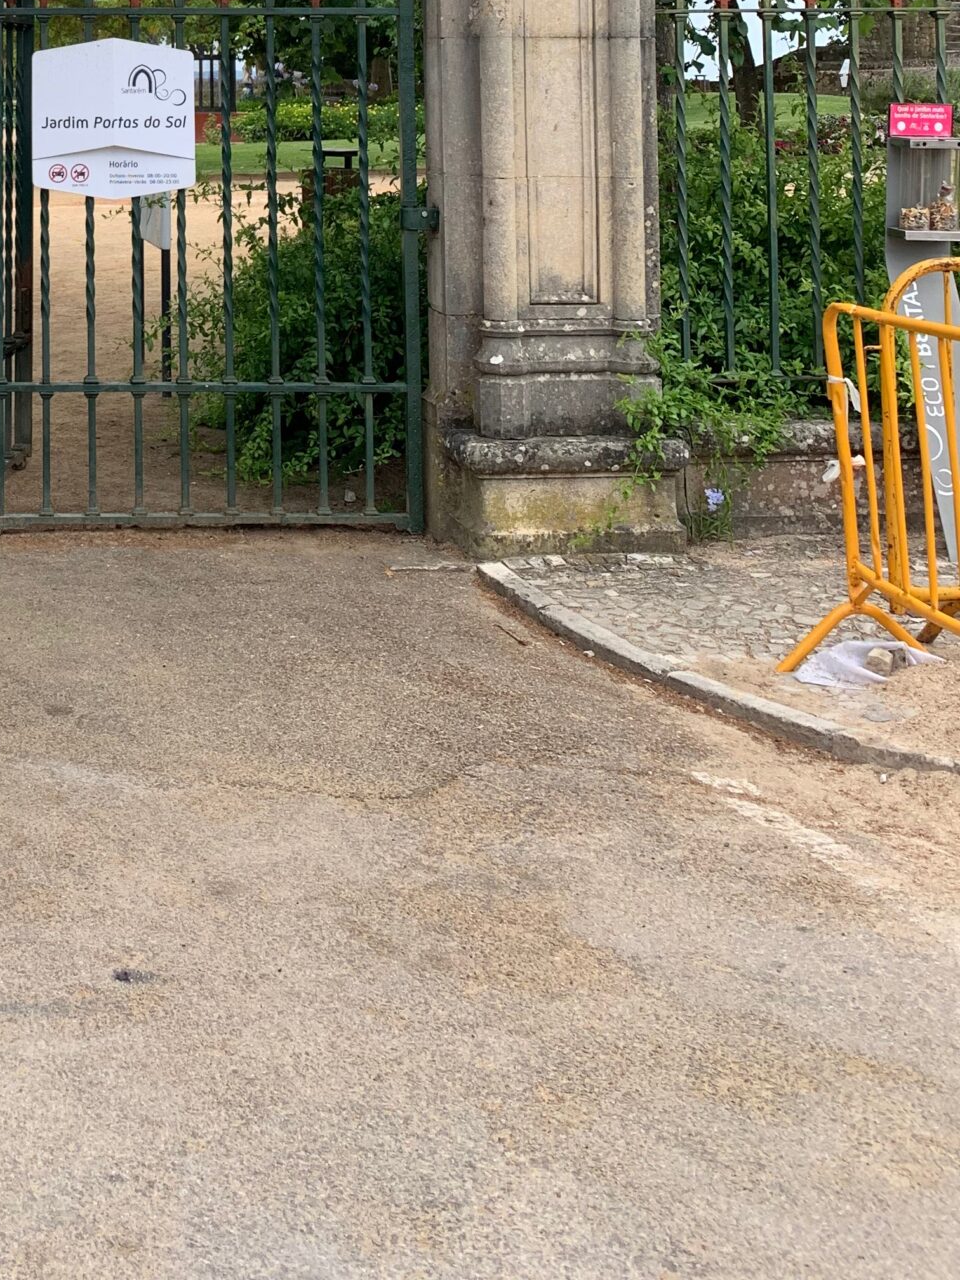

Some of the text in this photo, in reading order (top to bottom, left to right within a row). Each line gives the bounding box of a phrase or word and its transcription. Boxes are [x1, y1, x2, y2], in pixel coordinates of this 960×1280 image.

[41, 115, 187, 129] Jardim Portas do Sol
[109, 160, 139, 168] Horário
